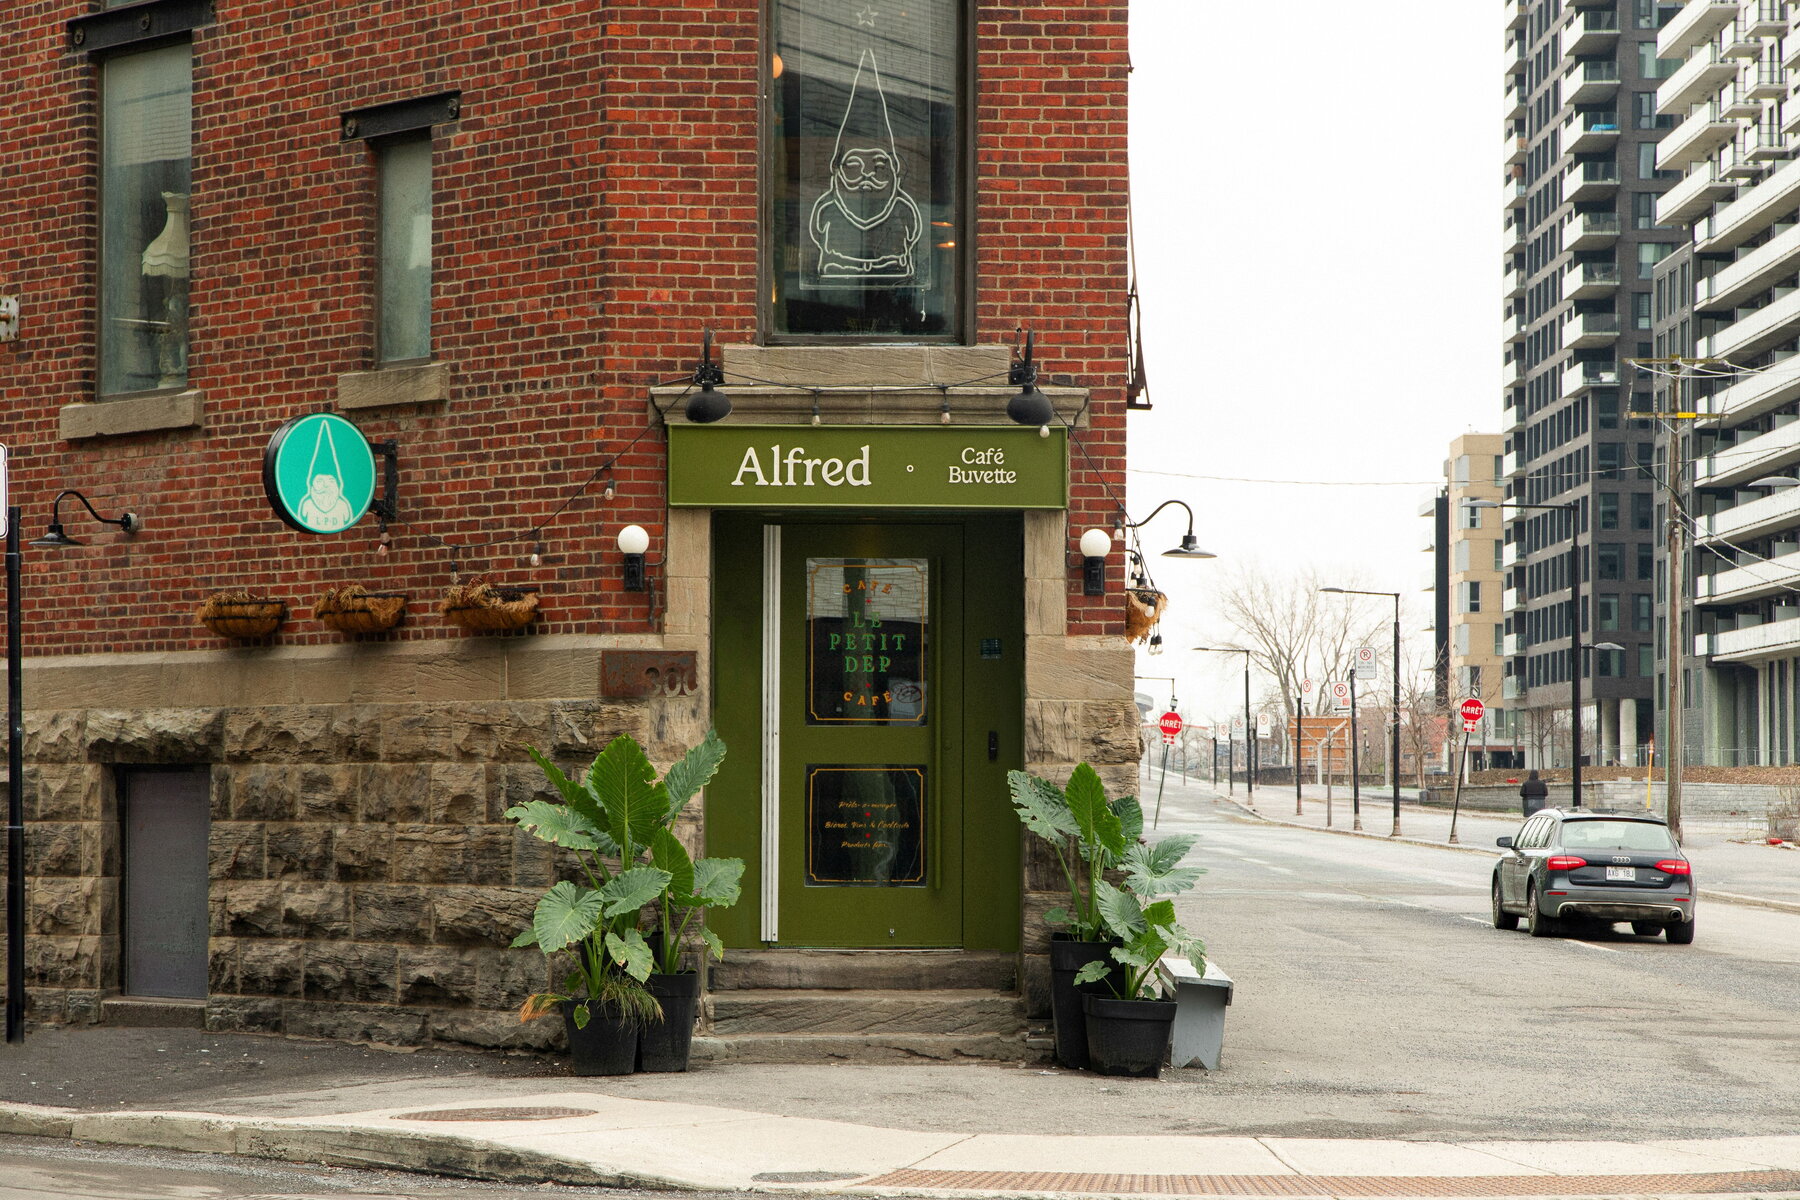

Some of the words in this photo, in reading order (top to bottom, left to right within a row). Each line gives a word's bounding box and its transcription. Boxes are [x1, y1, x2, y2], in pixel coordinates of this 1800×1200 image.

[961, 447, 1005, 465] Café
[731, 444, 872, 487] Alfred
[948, 465, 1017, 484] Buvette
[853, 611, 882, 628] LE
[829, 633, 906, 651] PETIT
[845, 656, 891, 673] DEP
[1461, 705, 1483, 716] ARRÊT
[1159, 719, 1181, 730] ARRÊT
